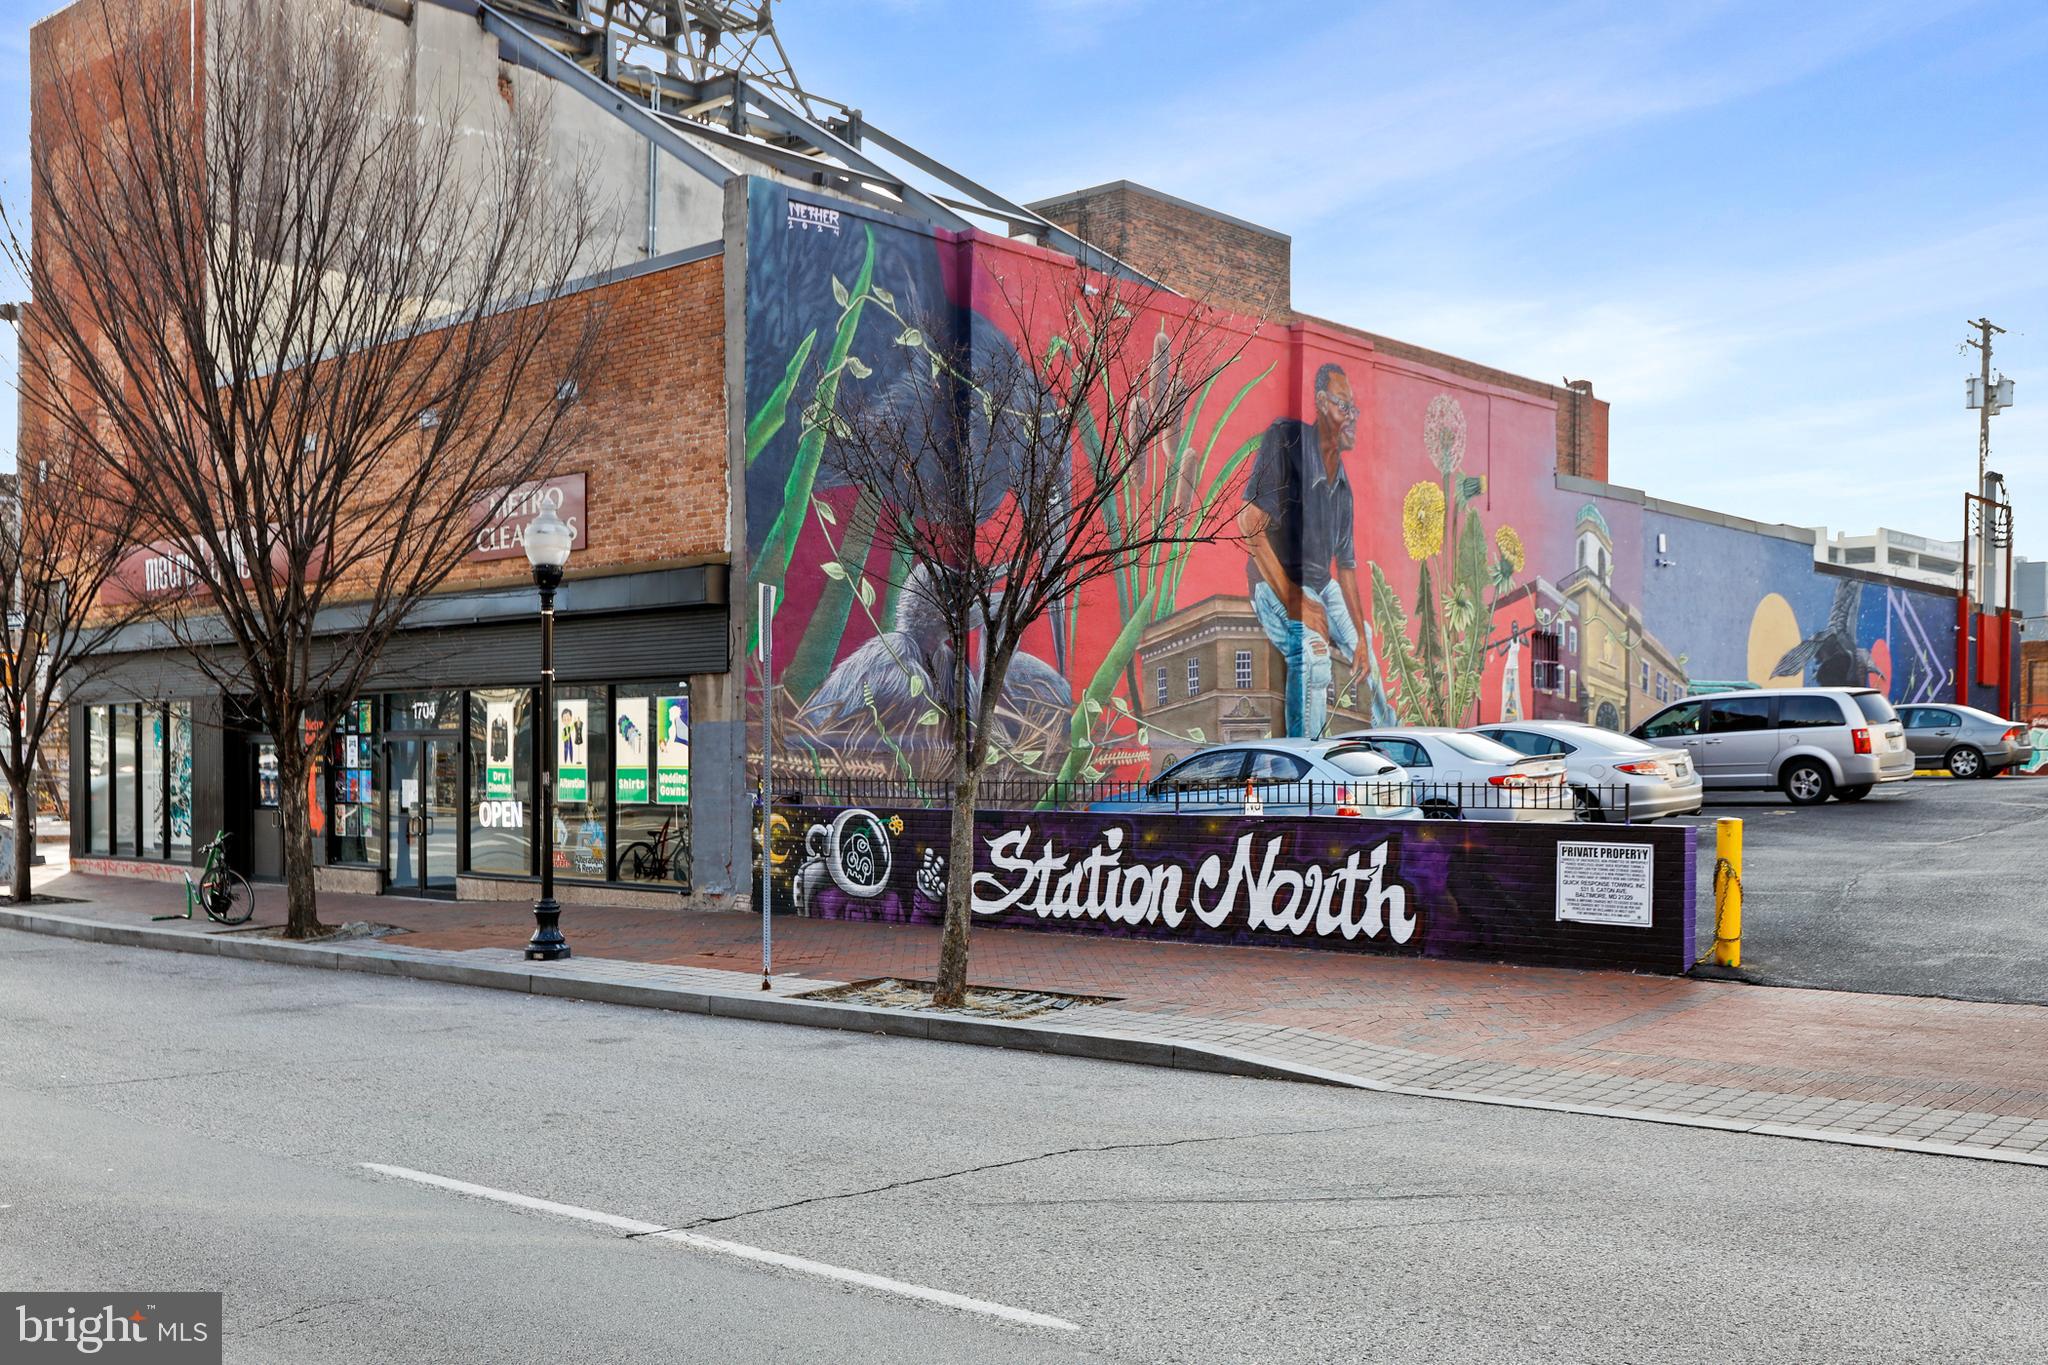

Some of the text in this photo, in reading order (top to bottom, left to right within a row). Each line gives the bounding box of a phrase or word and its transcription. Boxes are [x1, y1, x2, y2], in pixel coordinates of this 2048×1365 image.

[788, 201, 840, 225] NETHER
[489, 487, 564, 519] METRO
[476, 516, 578, 552] CLEAS
[412, 701, 436, 720] 1704
[493, 770, 506, 785] Dry
[618, 778, 646, 790] Shirts
[658, 772, 687, 785] Wedding
[660, 785, 687, 797] Gowns
[479, 801, 523, 828] OPEN
[1561, 846, 1648, 860] PRIVATE PROPERTY
[971, 825, 1417, 944] Station North
